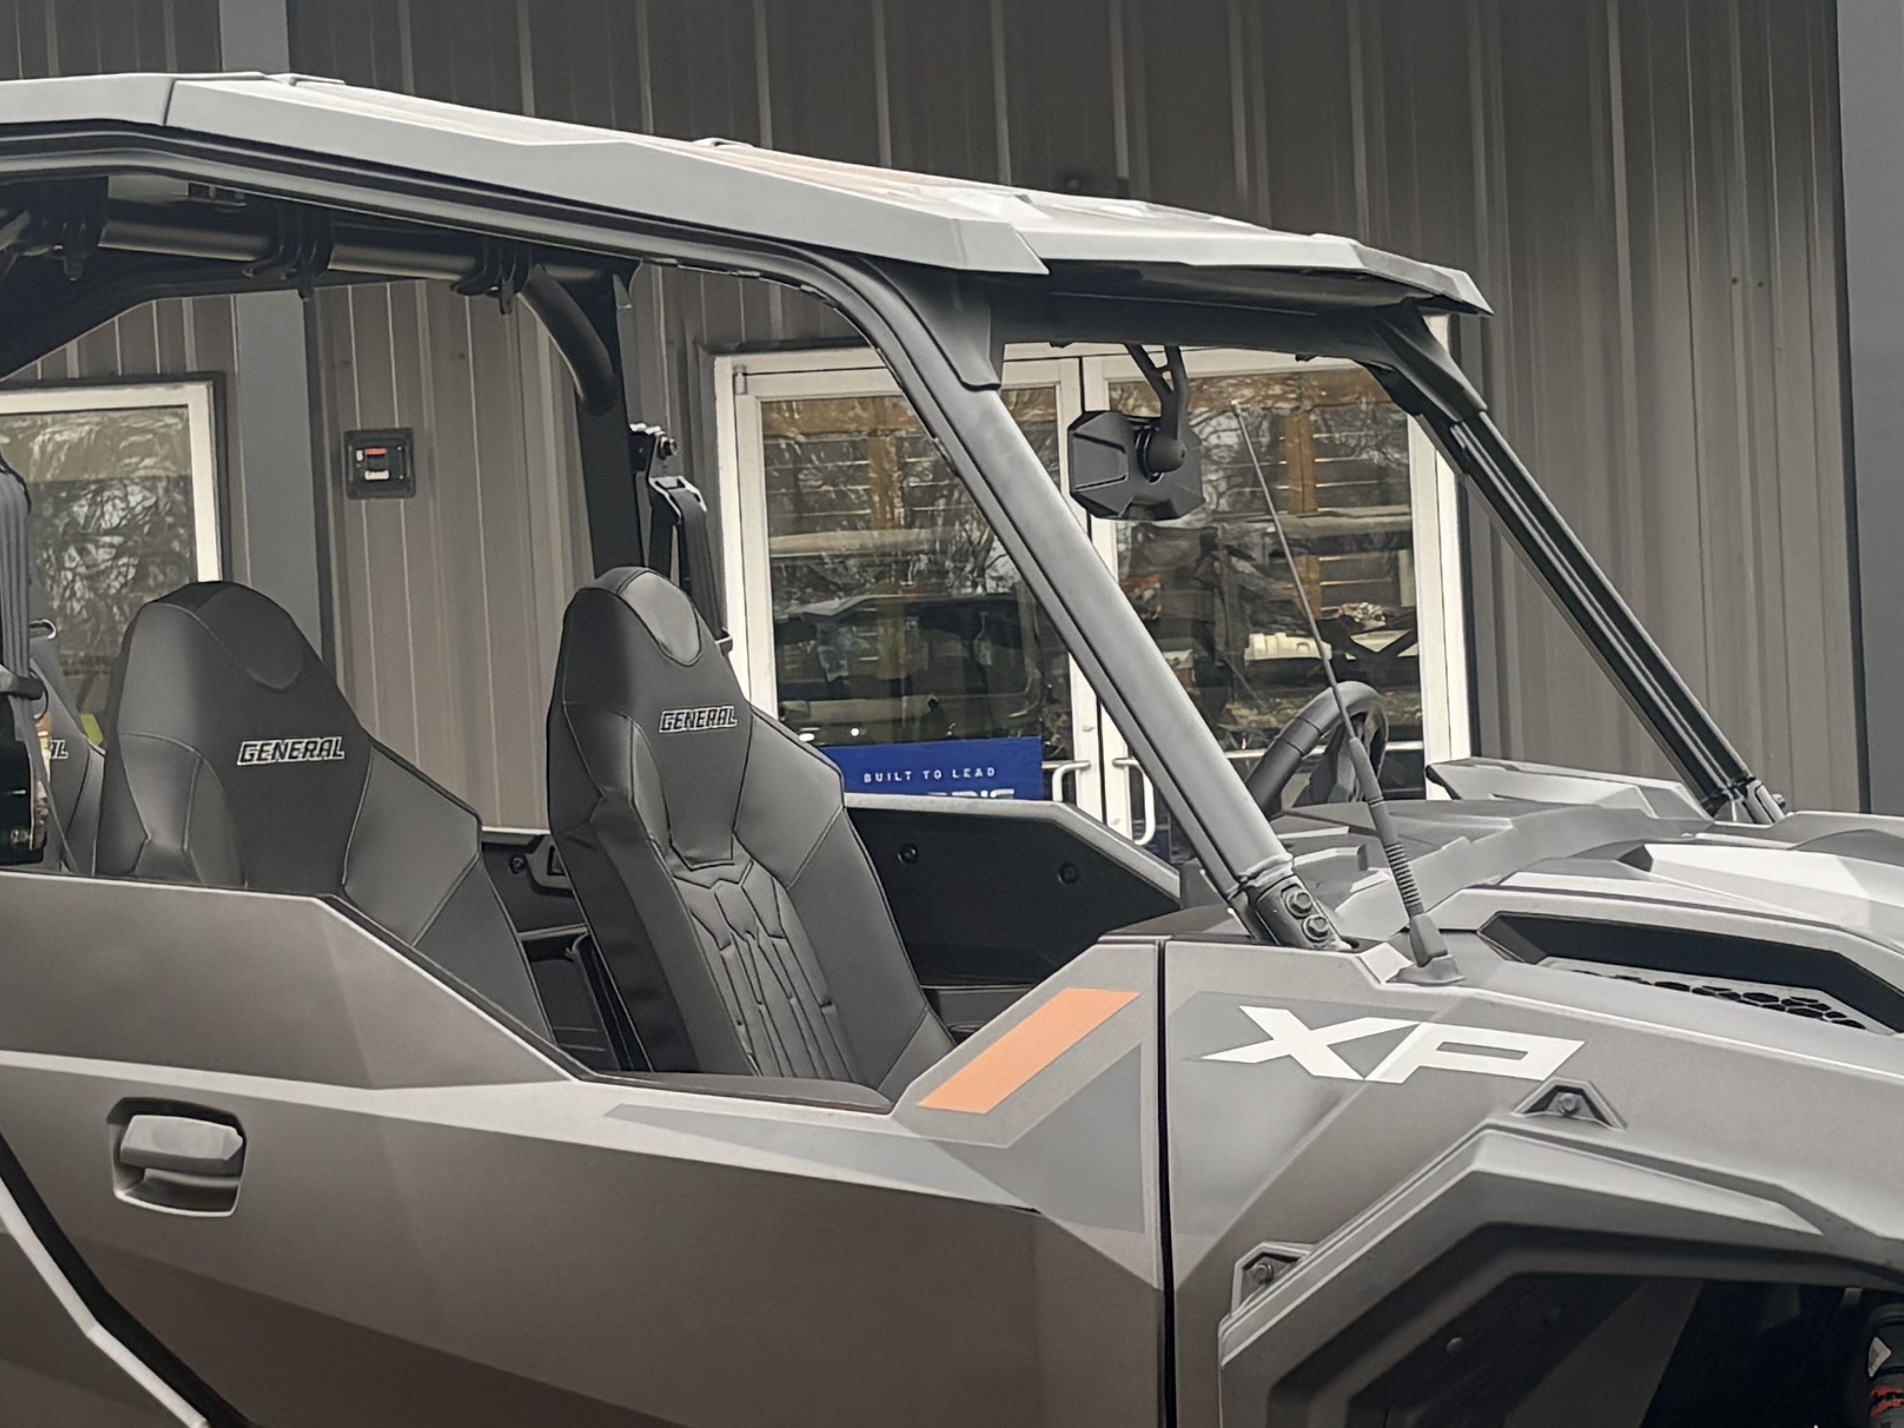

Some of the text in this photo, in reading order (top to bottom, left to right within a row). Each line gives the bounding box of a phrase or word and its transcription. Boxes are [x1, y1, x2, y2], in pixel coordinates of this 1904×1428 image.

[659, 705, 738, 734] GENERAL
[236, 736, 345, 767] GENERAL
[863, 766, 997, 783] BUILT TO LEAD
[1200, 1004, 1587, 1085] XP
